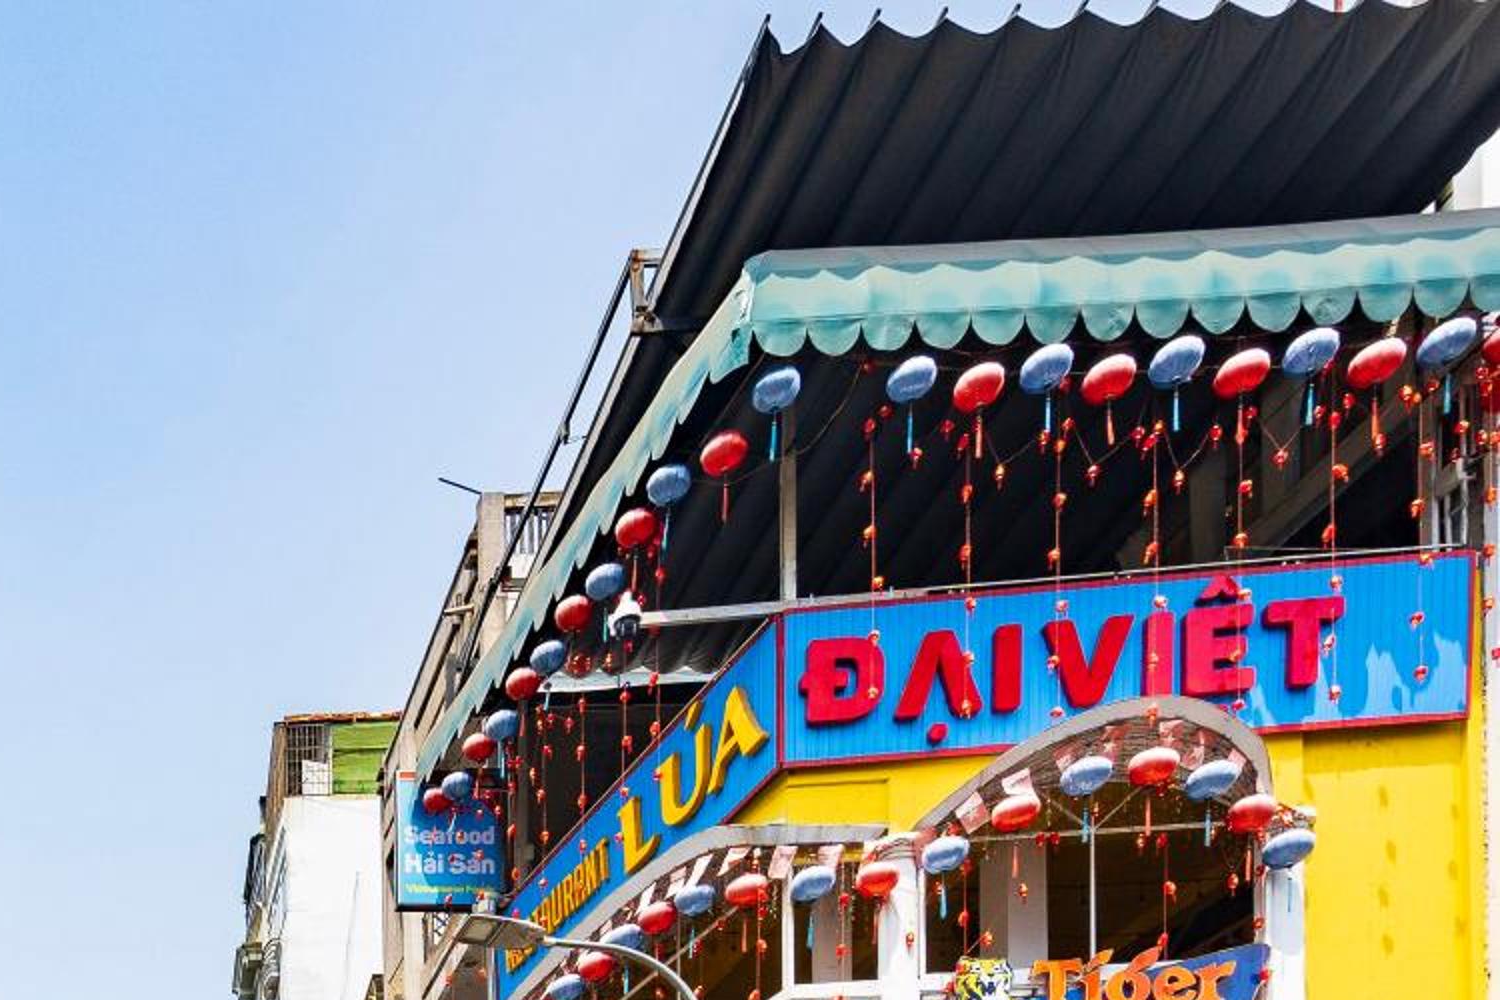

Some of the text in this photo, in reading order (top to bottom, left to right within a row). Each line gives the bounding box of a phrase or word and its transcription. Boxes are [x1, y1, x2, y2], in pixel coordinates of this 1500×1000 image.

[799, 622, 1022, 745] ĐẠI
[403, 825, 496, 845] Seafood
[617, 686, 769, 876] LÚA
